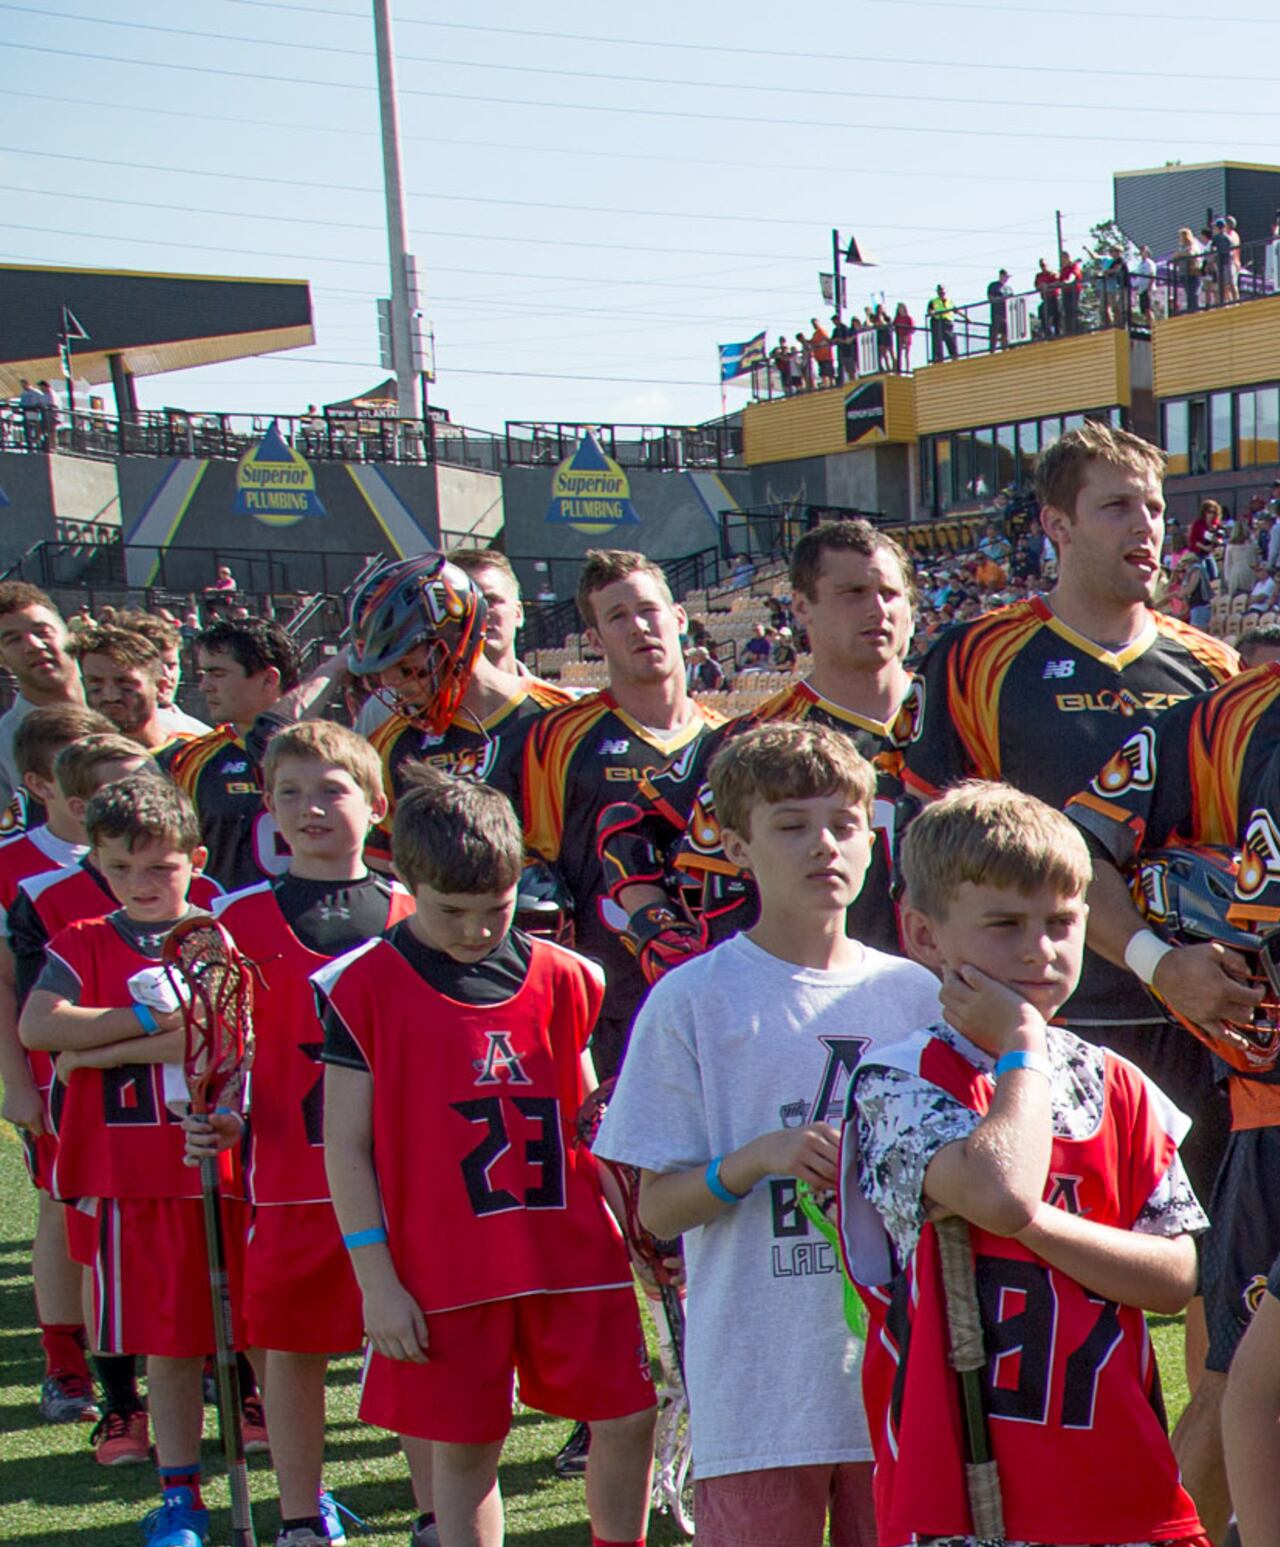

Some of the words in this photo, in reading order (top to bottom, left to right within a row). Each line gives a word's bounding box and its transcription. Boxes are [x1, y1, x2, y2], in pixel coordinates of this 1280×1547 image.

[1008, 297, 1027, 342] 110
[241, 462, 309, 487] Superior
[557, 473, 623, 497] Superior
[245, 490, 309, 511] PLUMBING
[560, 499, 623, 520] PLUMBING
[473, 1030, 534, 1087] A
[448, 1095, 568, 1218] 23
